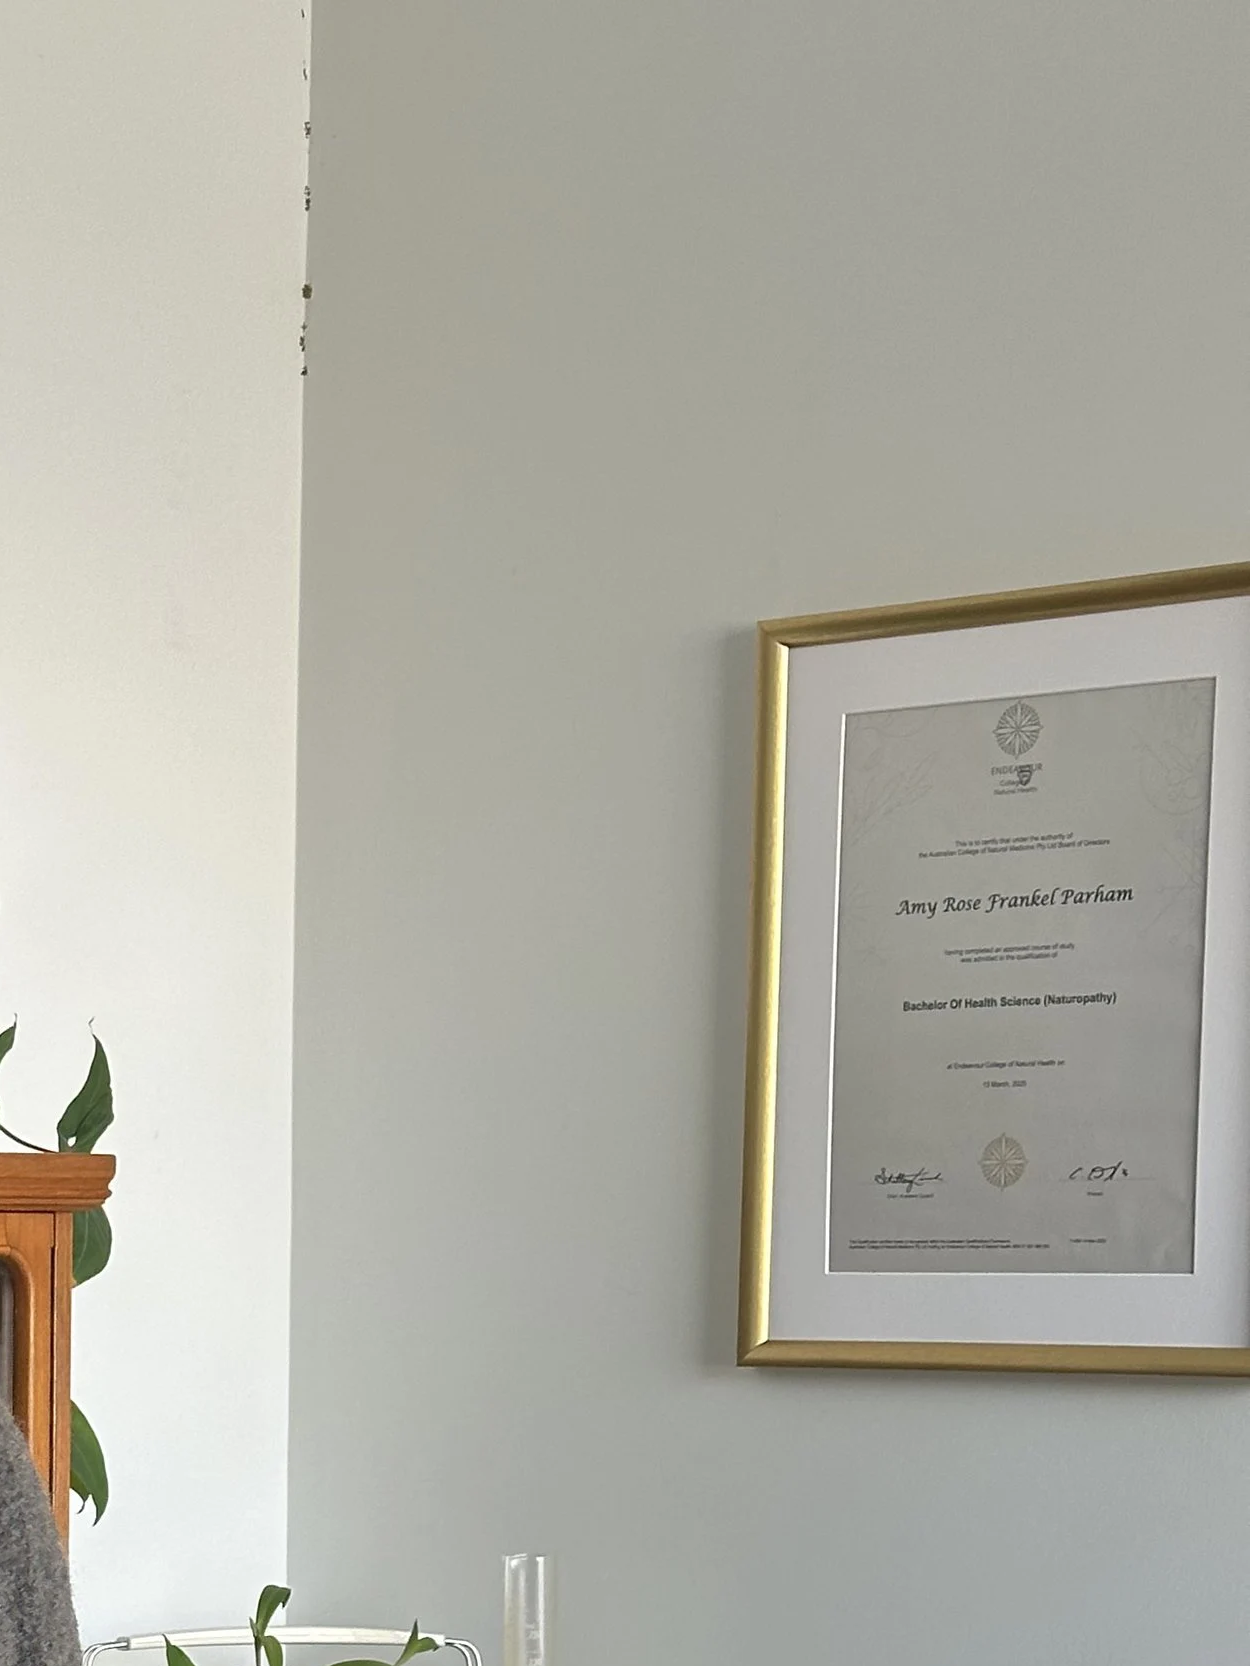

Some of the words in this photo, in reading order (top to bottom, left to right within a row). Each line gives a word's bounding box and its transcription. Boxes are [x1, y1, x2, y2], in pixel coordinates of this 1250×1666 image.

[991, 763, 1042, 776] ENDEAUR
[895, 900, 937, 919] Amy
[943, 897, 982, 913] Rose
[985, 888, 1060, 914] Frankel
[1060, 884, 1134, 905] Parham
[903, 1000, 948, 1012] Bachelor
[949, 998, 963, 1010] Of
[964, 997, 998, 1009] Health
[1000, 996, 1041, 1007] Science
[1043, 991, 1118, 1007] (Naturopathy)
